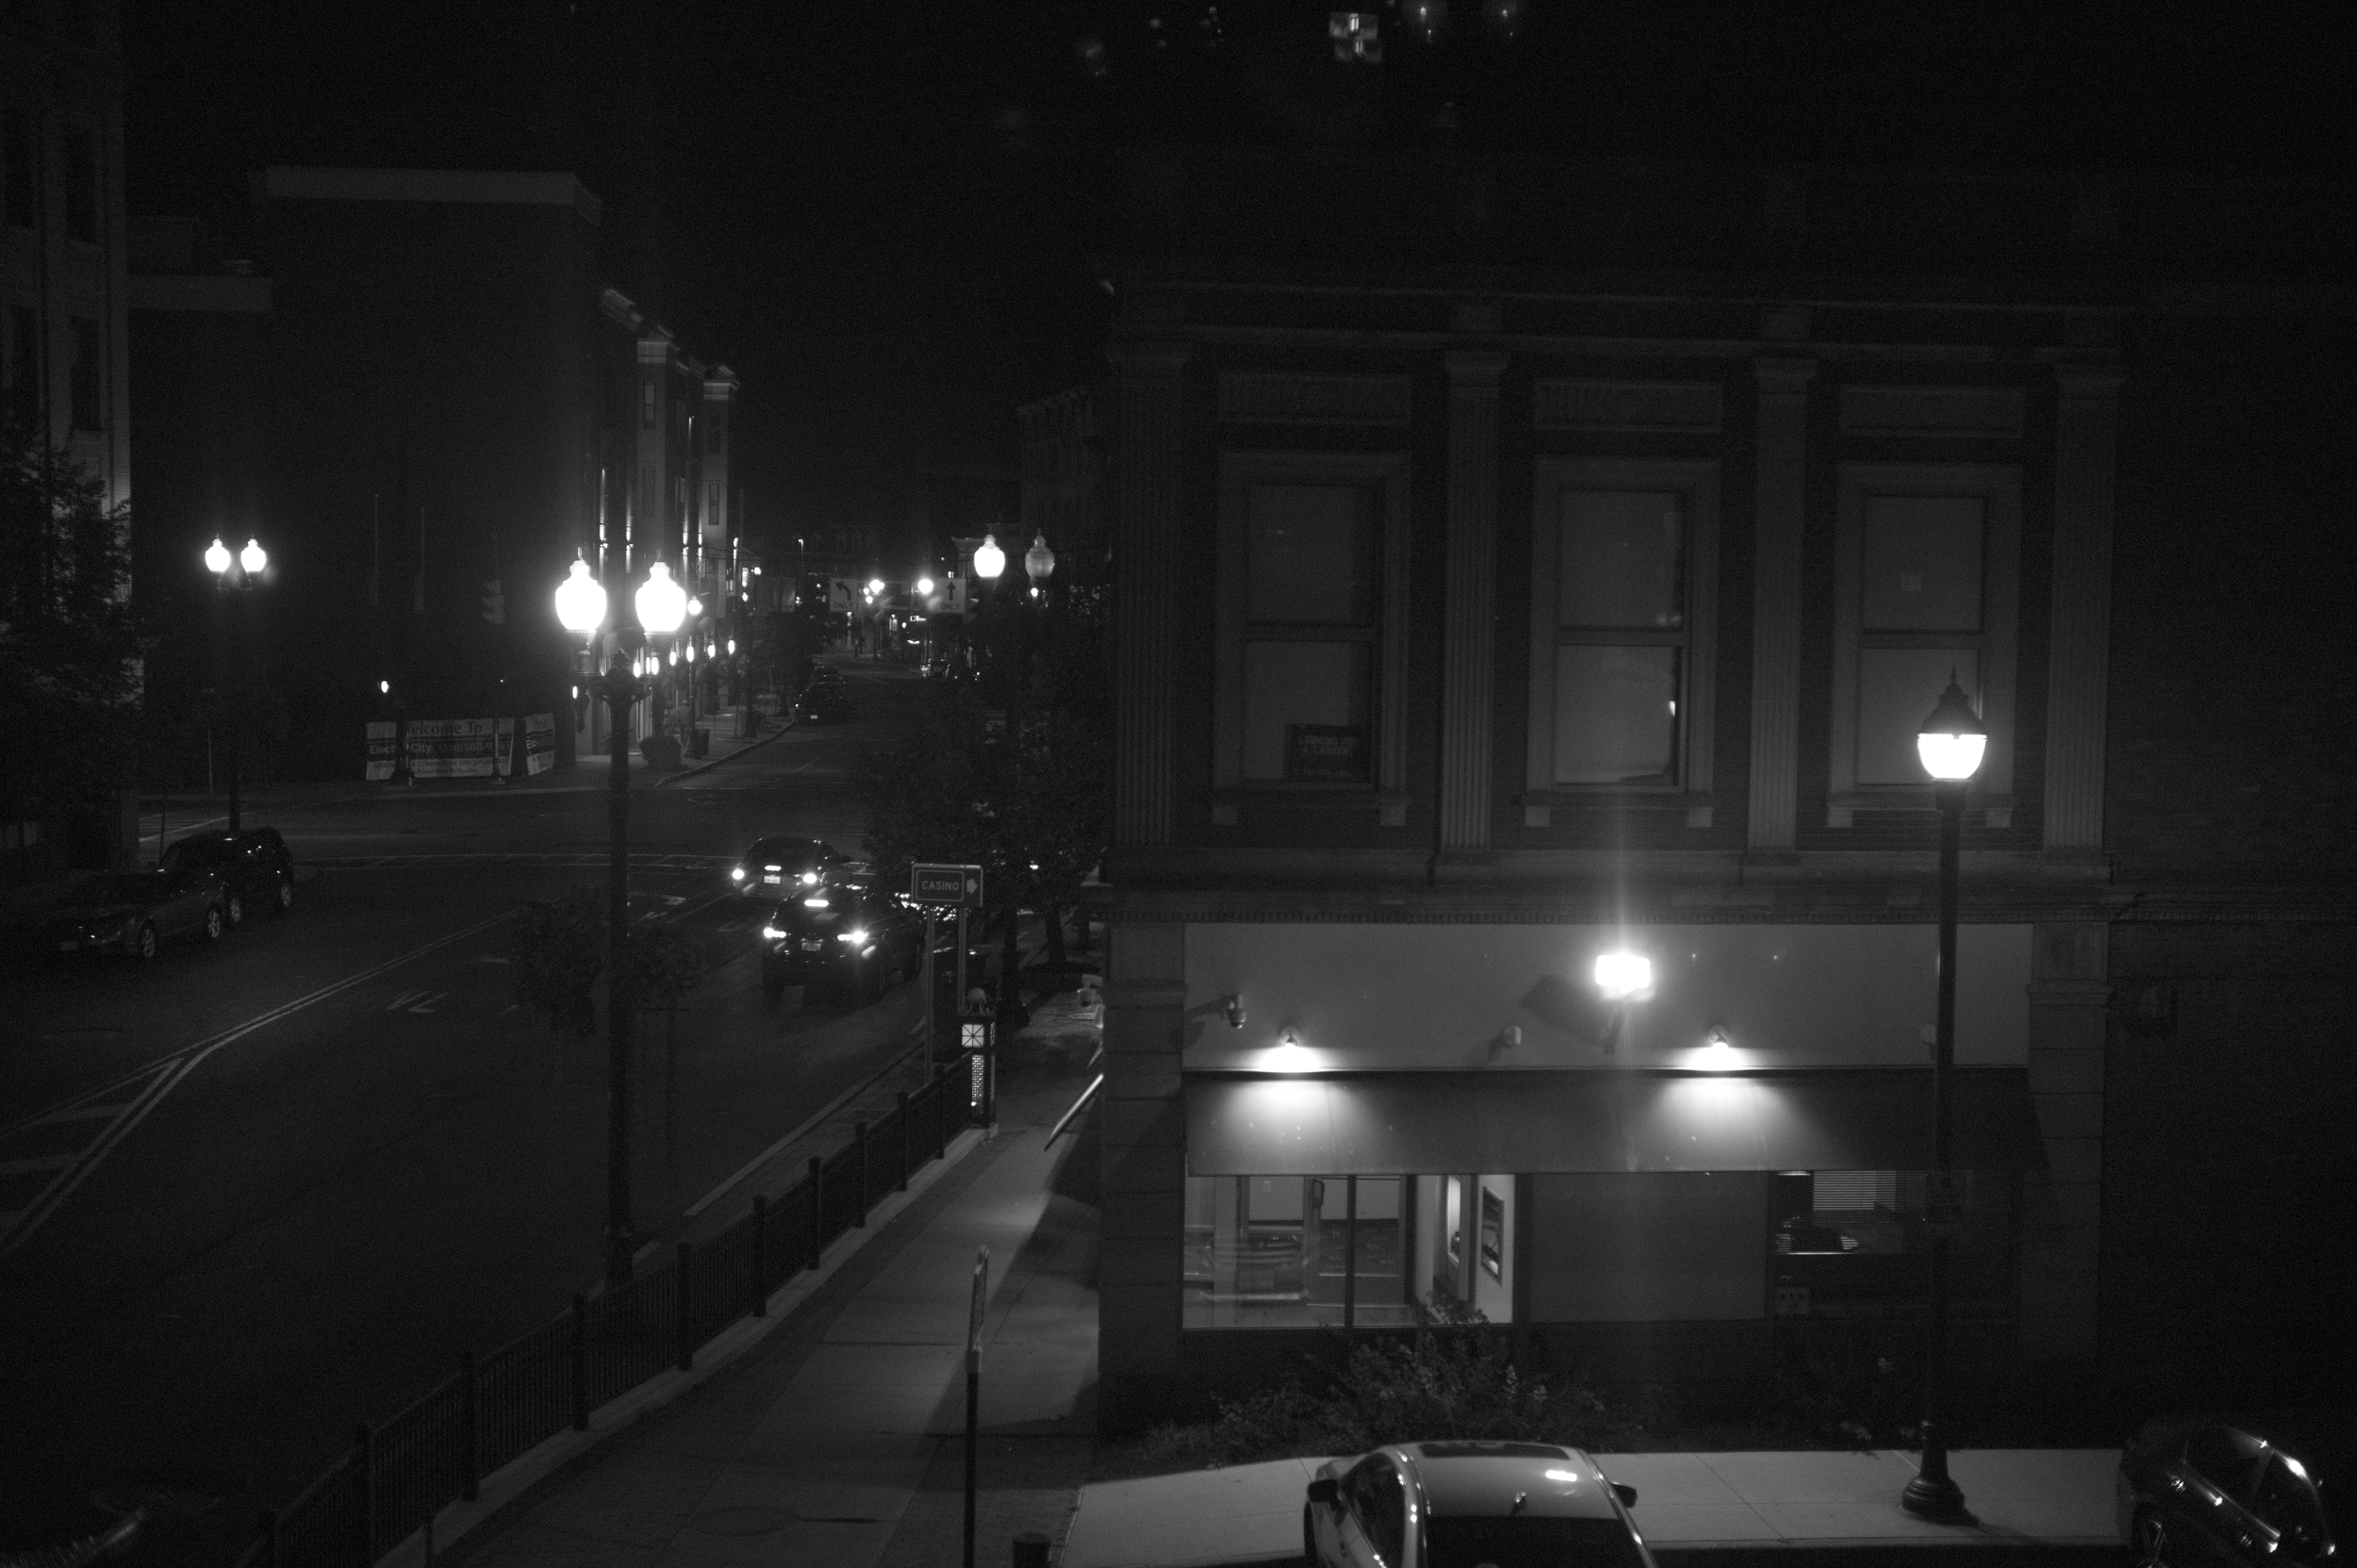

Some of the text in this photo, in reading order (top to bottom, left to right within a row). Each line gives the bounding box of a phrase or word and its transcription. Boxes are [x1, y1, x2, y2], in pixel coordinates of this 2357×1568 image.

[409, 720, 483, 734] elcome To
[369, 743, 397, 754] Elect
[410, 741, 432, 754] City
[921, 880, 960, 891] CASINO
